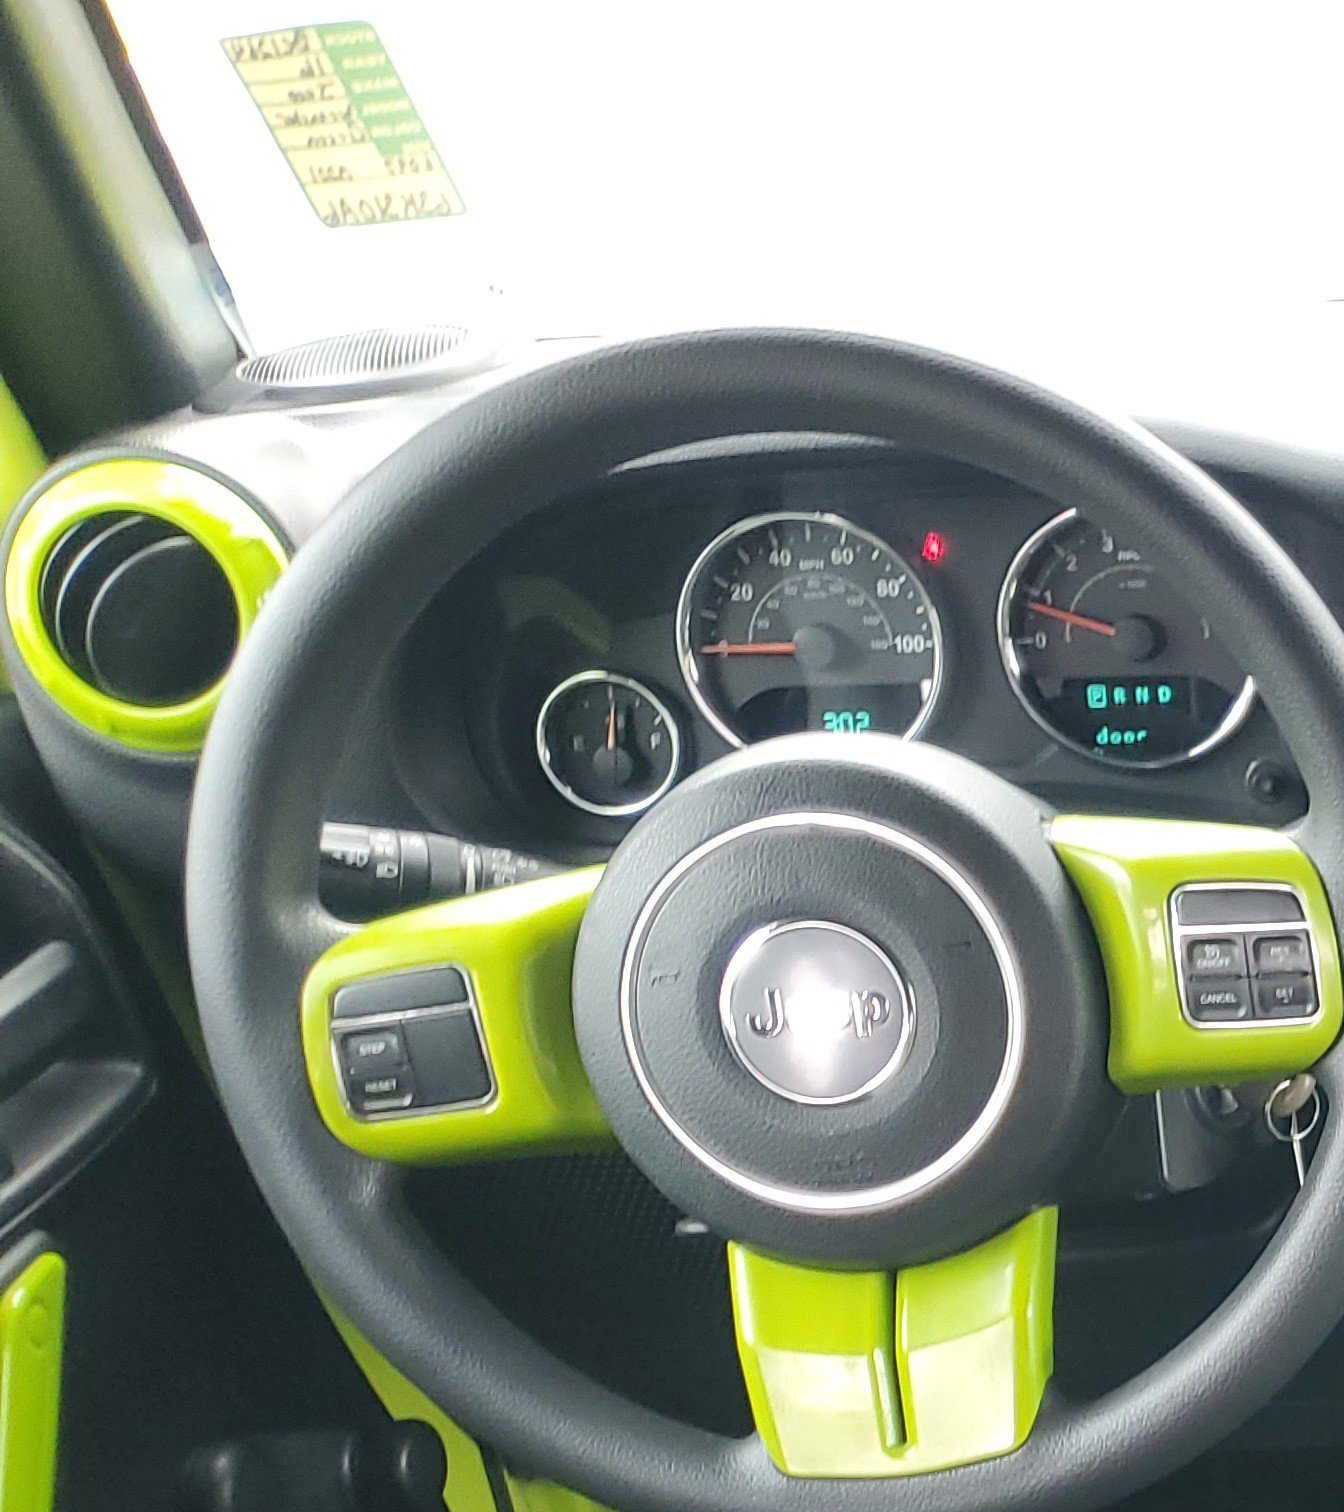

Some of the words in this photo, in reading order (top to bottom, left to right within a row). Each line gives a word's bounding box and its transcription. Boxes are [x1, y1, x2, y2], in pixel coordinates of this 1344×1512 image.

[768, 548, 792, 567] 40
[1066, 554, 1077, 572] 2
[729, 582, 754, 602] 20
[893, 634, 926, 654] 100
[1035, 632, 1047, 650] 0
[1157, 685, 1173, 704] D
[1096, 725, 1148, 745] door
[1200, 991, 1237, 1005] CANCEL
[745, 986, 891, 1040] Jp
